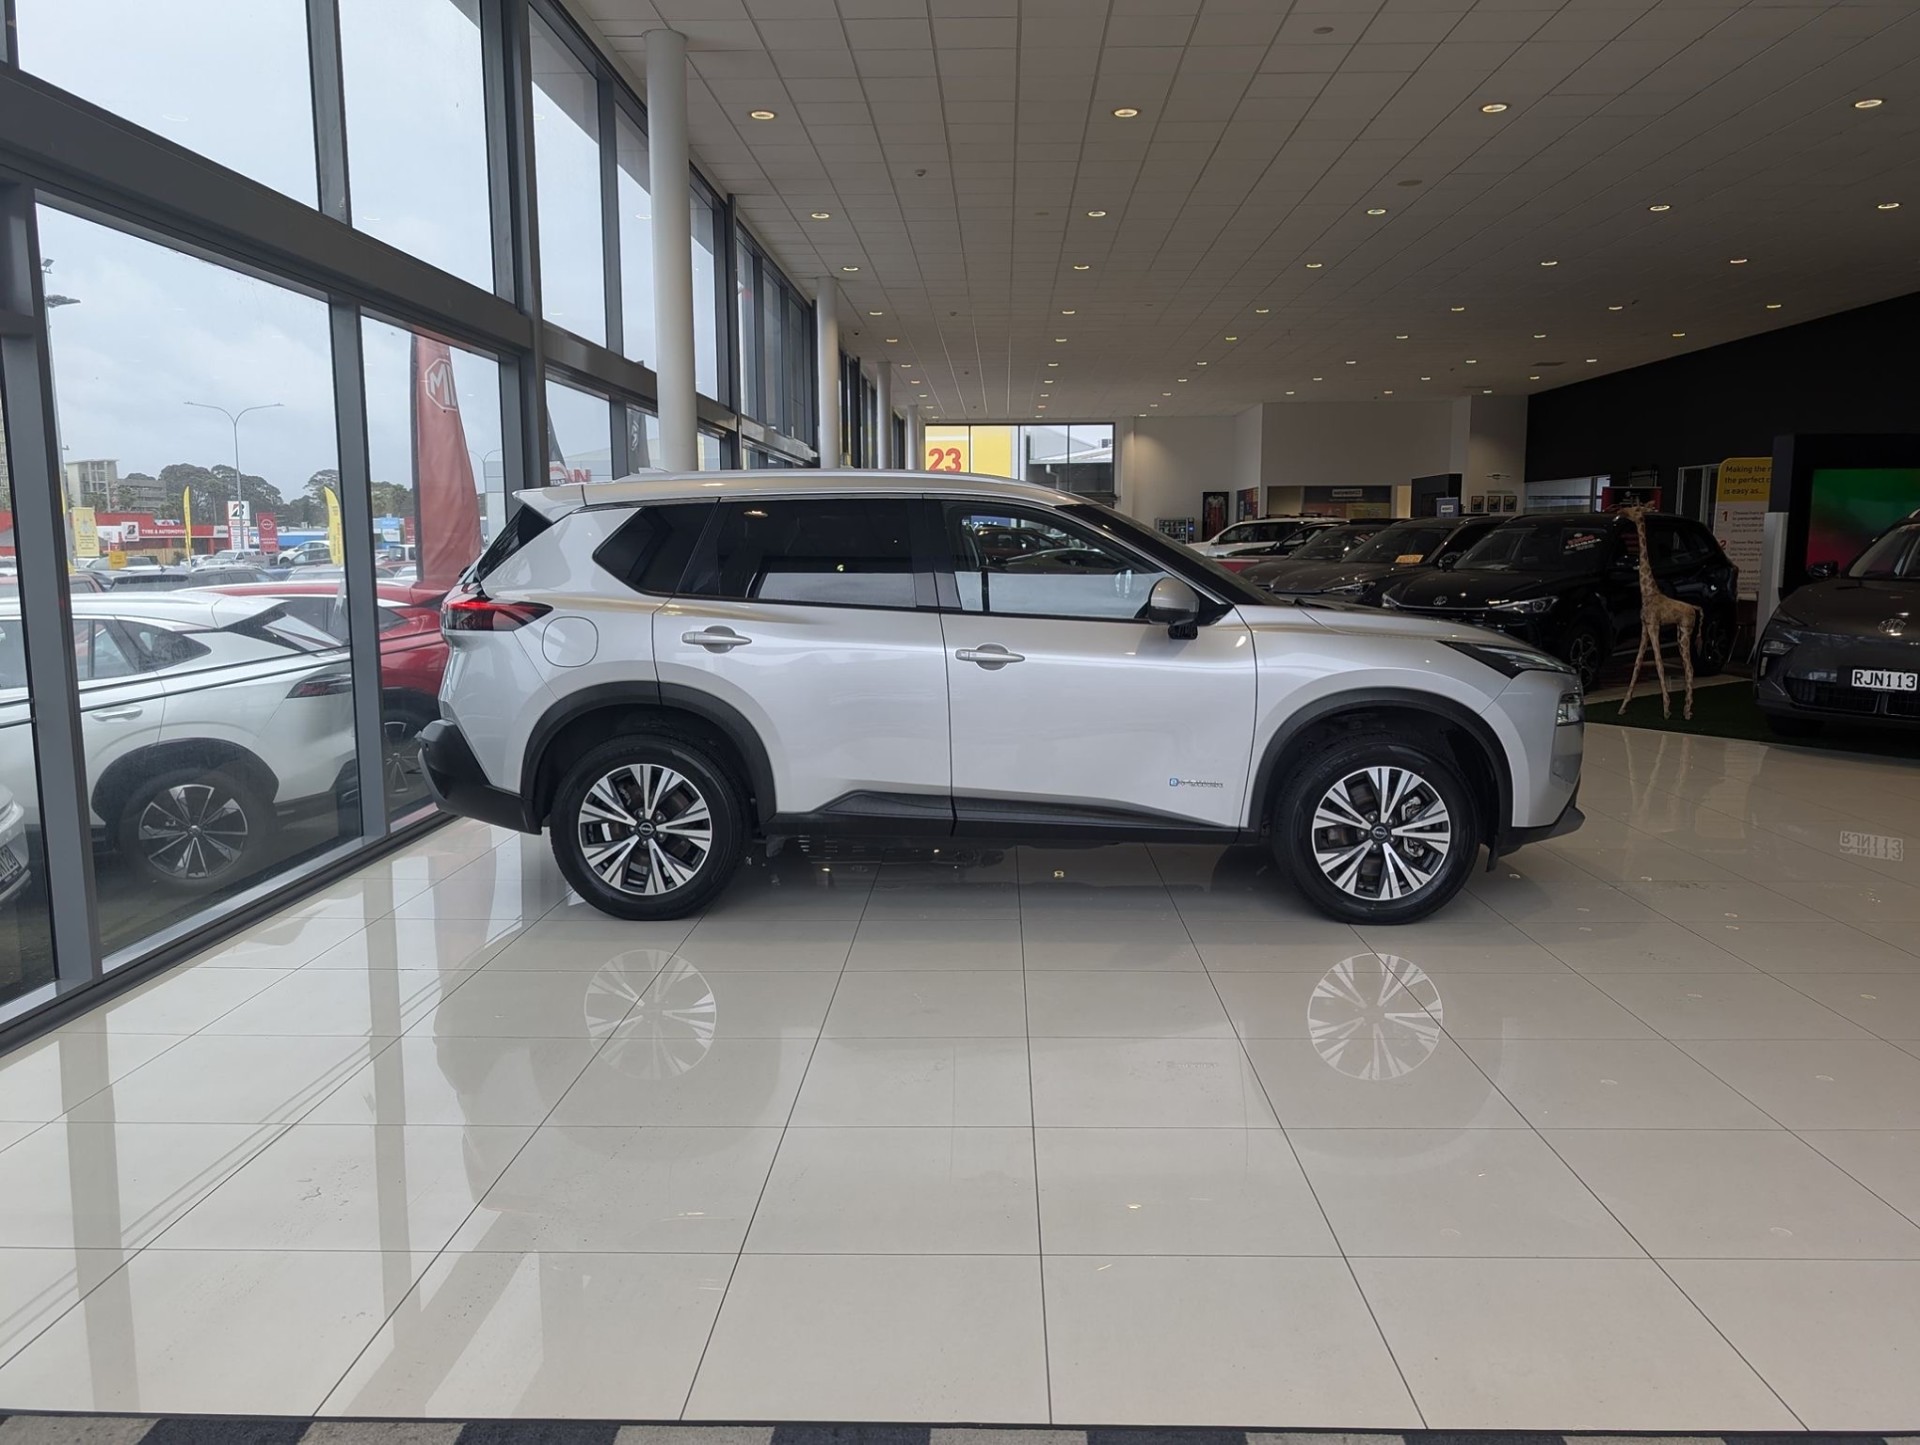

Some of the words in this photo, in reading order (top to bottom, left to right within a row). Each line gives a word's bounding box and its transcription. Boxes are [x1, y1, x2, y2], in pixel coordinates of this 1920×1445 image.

[928, 447, 962, 472] 23
[1725, 465, 1753, 473] Making
[1754, 464, 1766, 472] the
[1738, 476, 1765, 484] perfect
[1722, 511, 1728, 522] 1
[1853, 671, 1916, 689] RJN113
